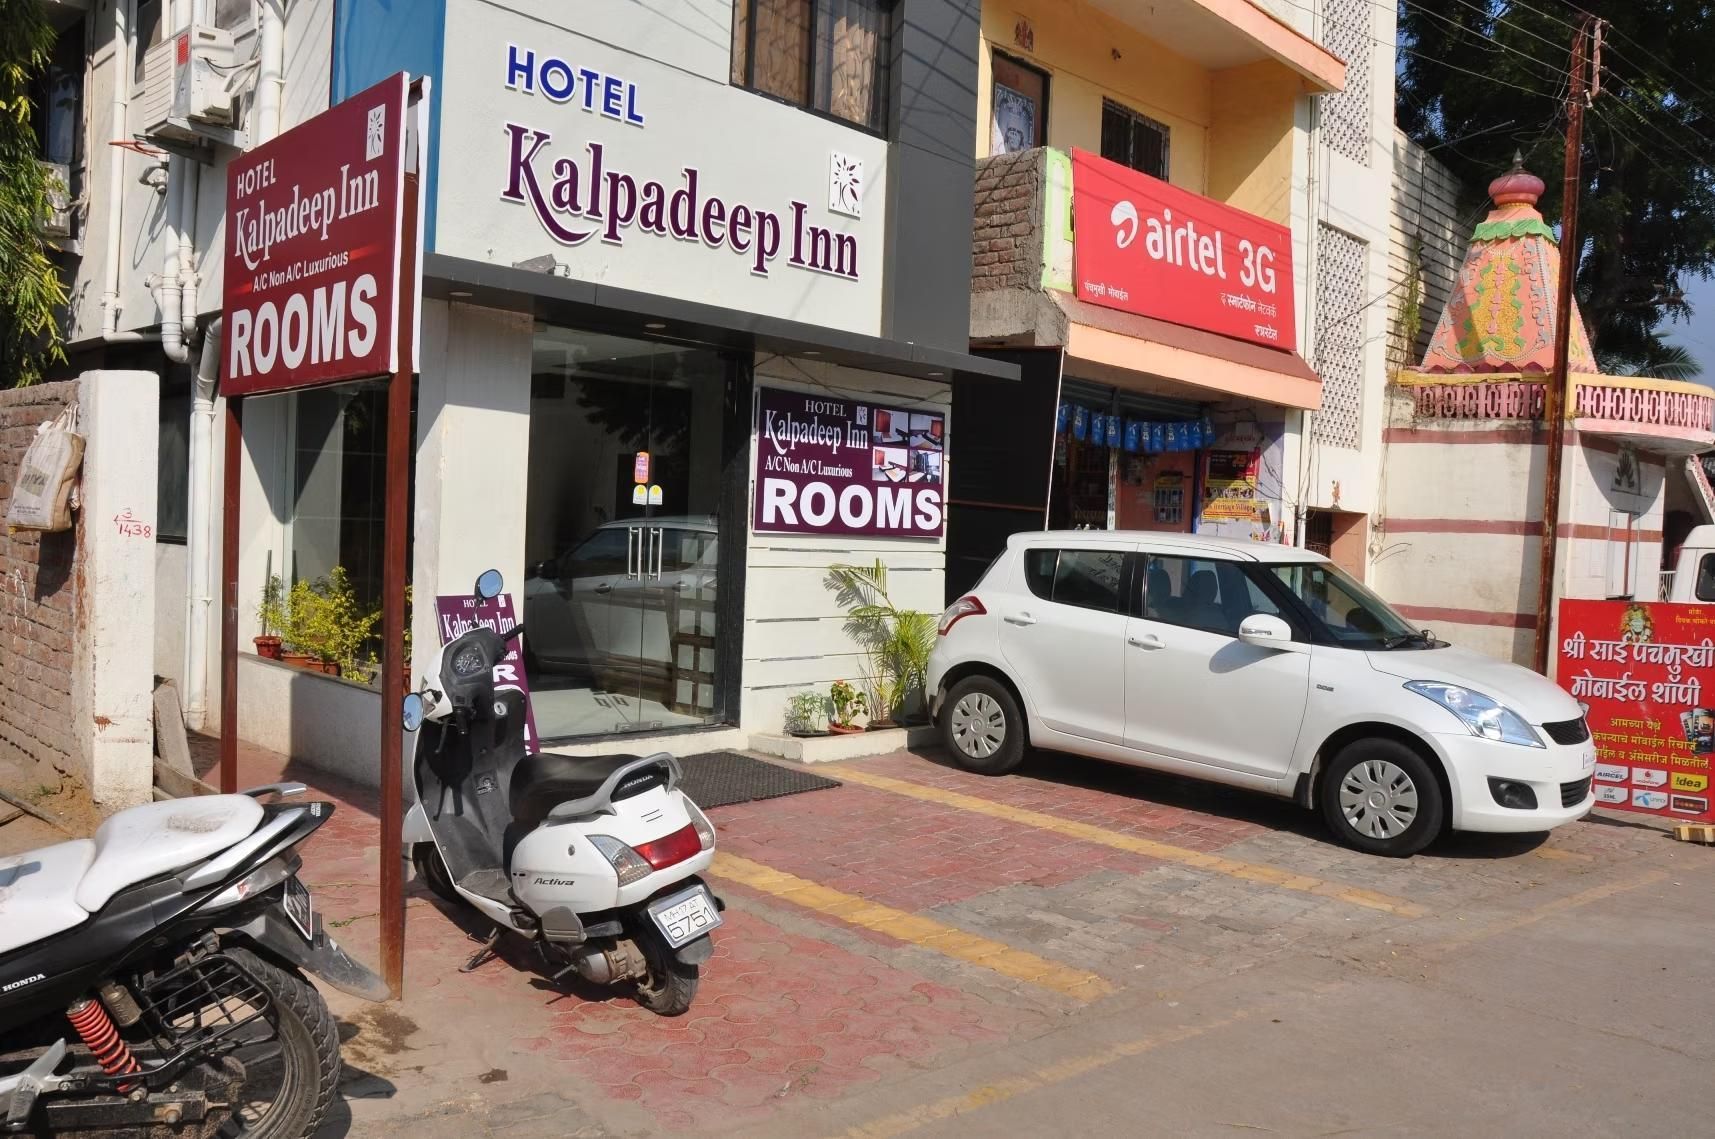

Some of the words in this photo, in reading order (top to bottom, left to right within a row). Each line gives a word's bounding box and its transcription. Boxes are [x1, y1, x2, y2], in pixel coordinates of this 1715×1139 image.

[505, 42, 645, 126] HOTEL
[236, 158, 276, 199] HOTEL
[234, 183, 335, 270] Kalpadeep
[338, 163, 379, 220] Inn
[501, 121, 781, 275] Kalpadeep
[788, 201, 859, 280] Inn
[1146, 208, 1227, 280] airtel
[1238, 239, 1276, 294] 3G
[253, 271, 268, 293] A/C
[269, 270, 285, 289] Non
[286, 262, 302, 283] A/C
[303, 251, 349, 277] Luxurious
[230, 273, 378, 379] ROOMS
[805, 399, 847, 417] HOTEL
[764, 409, 842, 455] Kalpadeep
[845, 420, 869, 449] Inn
[765, 455, 782, 472] A/C
[783, 456, 800, 473] Non
[800, 458, 817, 475] A/C
[818, 460, 853, 478] Luxurious
[762, 477, 942, 531] ROOMS
[119, 523, 151, 538] 1438
[1563, 631, 1586, 659] श्री
[1589, 634, 1629, 663] साई
[1571, 668, 1648, 702] मोबाईल
[1651, 674, 1701, 706] शॉपी
[534, 877, 575, 886] Activa
[667, 906, 715, 939] 5751
[2, 973, 46, 992] HONDA
